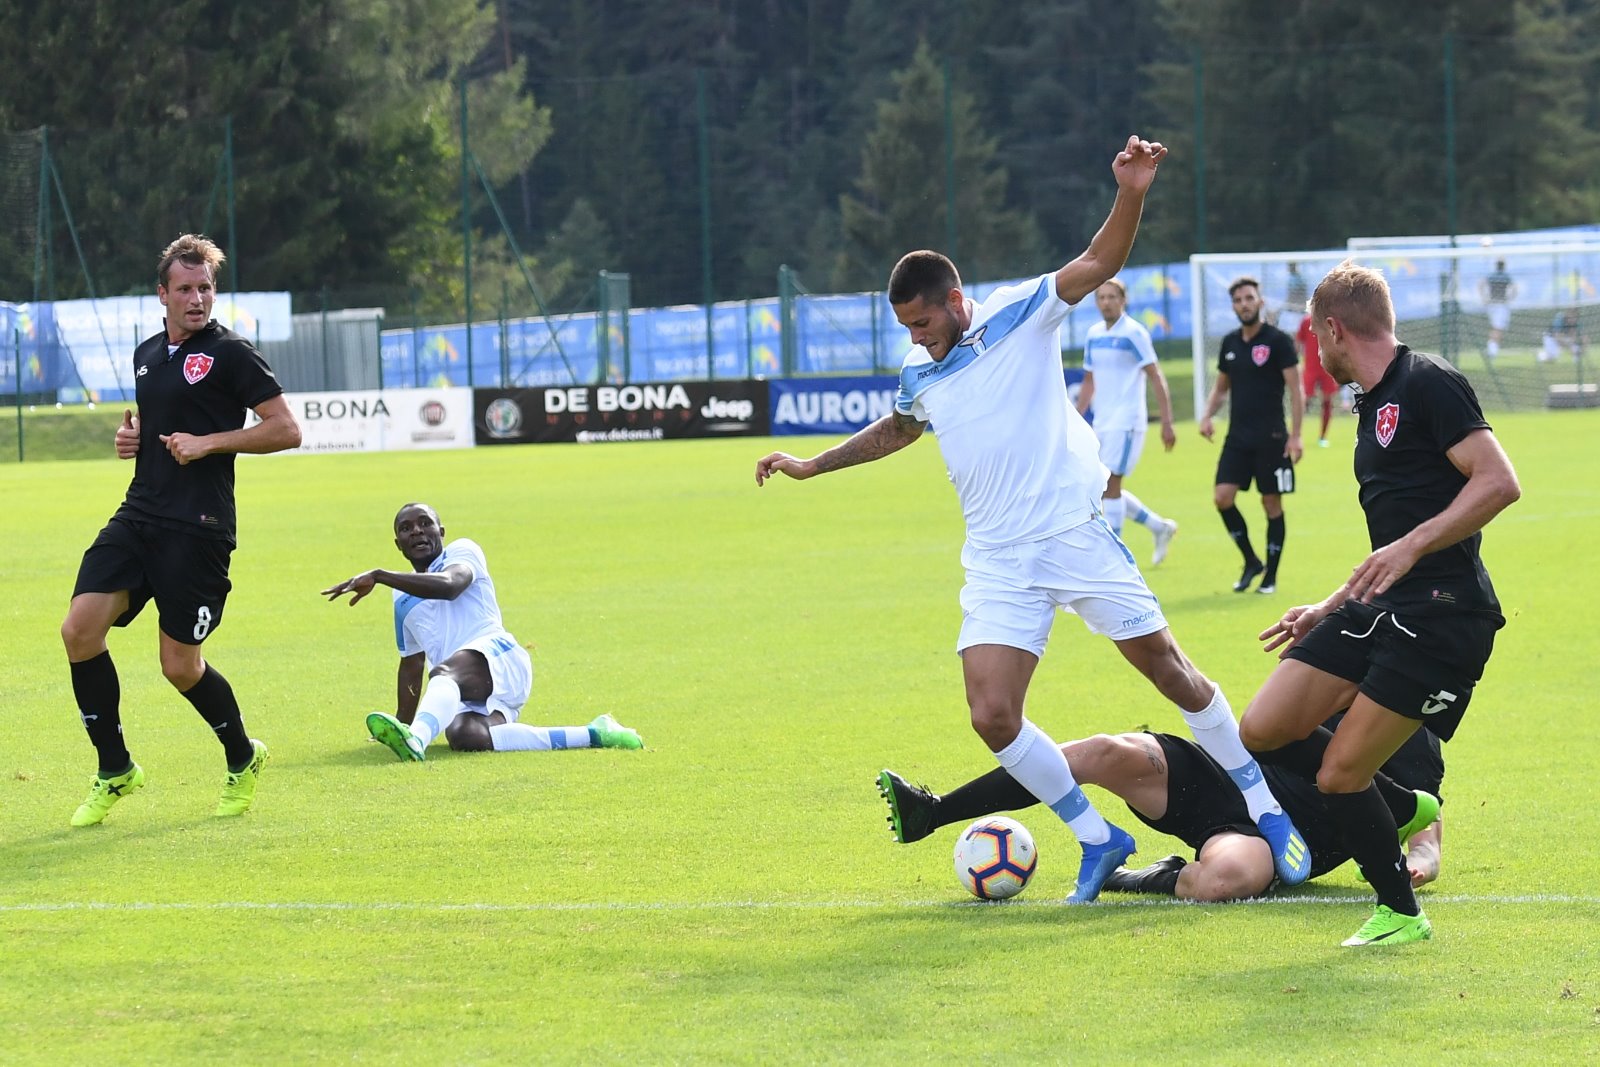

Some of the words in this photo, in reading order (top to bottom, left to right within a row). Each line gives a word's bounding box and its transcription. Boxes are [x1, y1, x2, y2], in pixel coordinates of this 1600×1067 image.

[304, 399, 391, 421] BONA
[544, 388, 589, 413] DE
[596, 384, 692, 412] BONA
[700, 397, 755, 421] Jeep
[774, 389, 898, 425] AURON
[1274, 466, 1294, 494] 10
[193, 605, 212, 641] 8
[1421, 689, 1458, 716] 5
